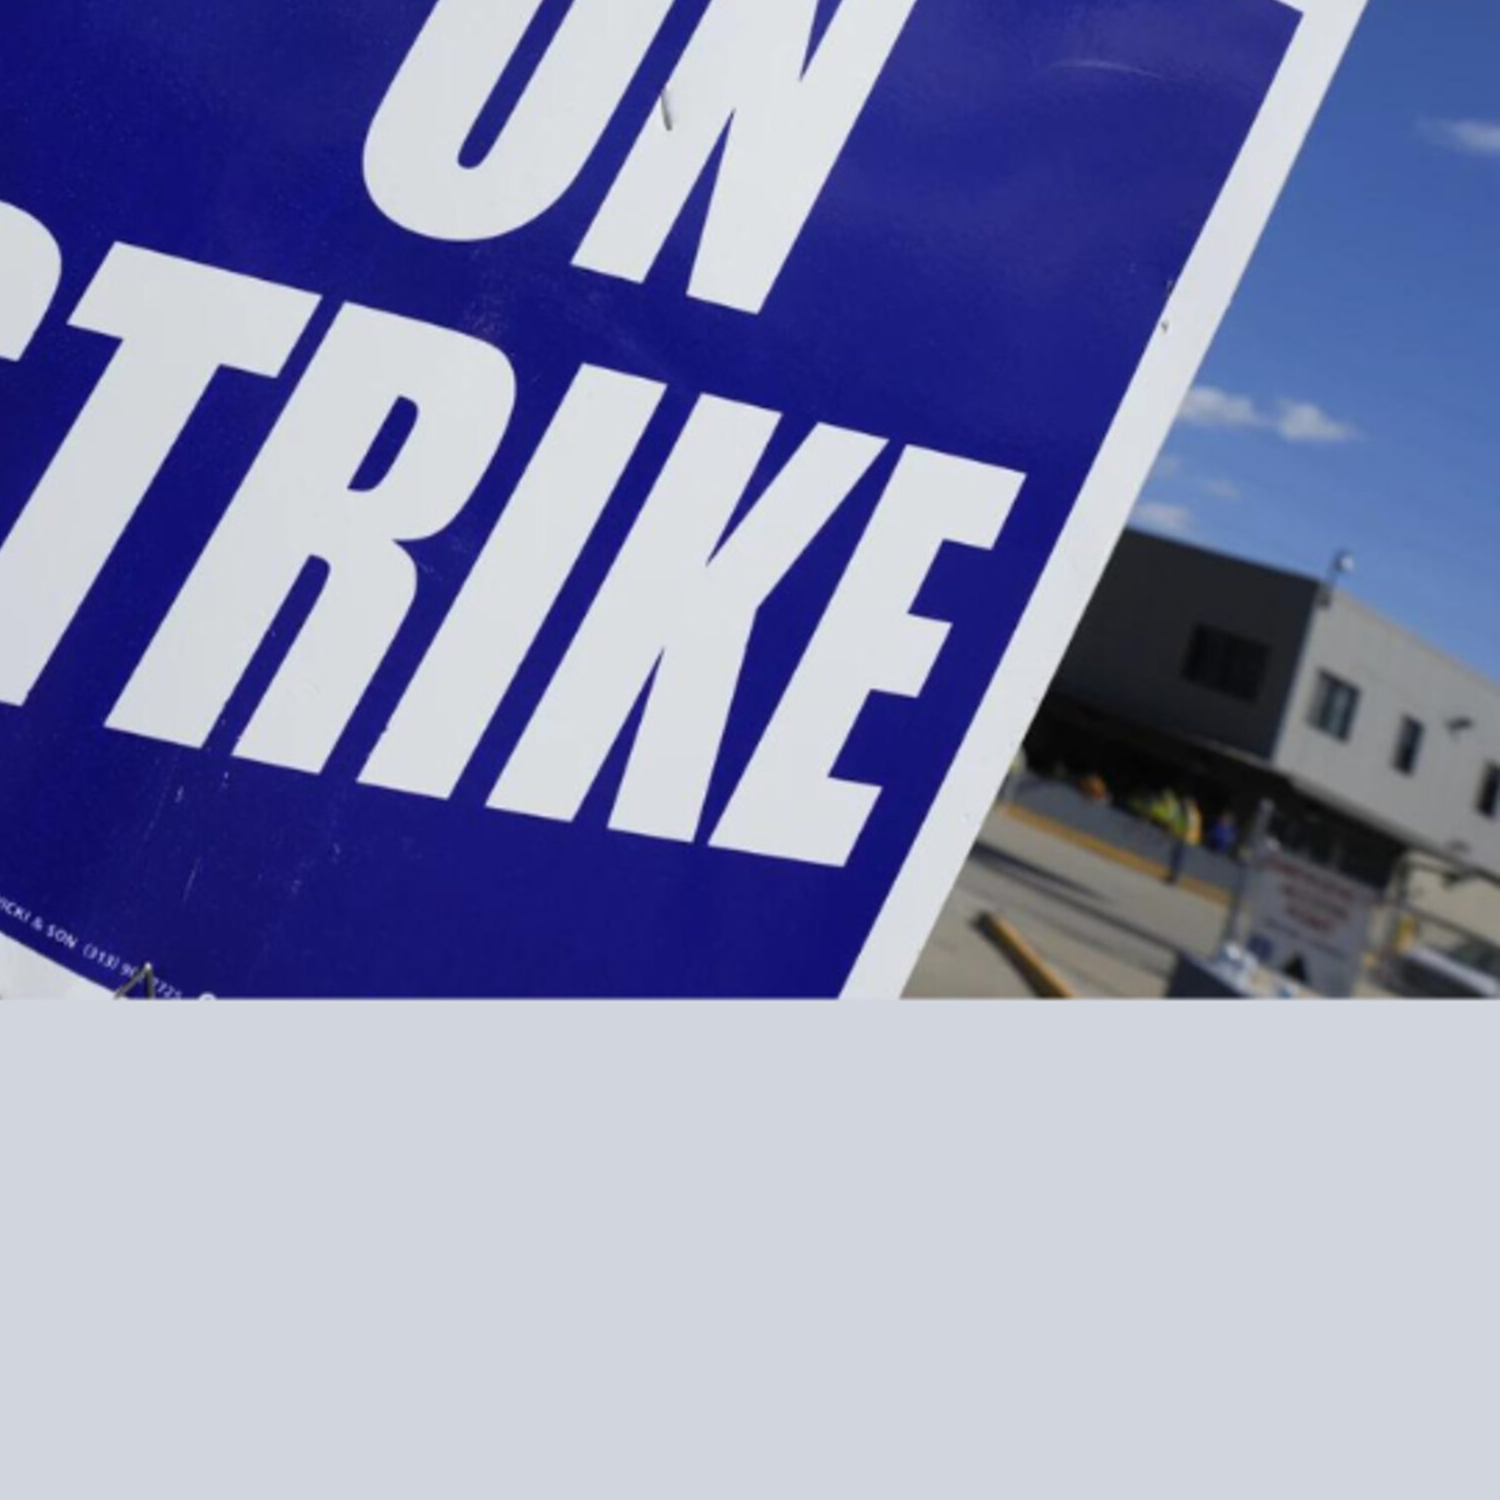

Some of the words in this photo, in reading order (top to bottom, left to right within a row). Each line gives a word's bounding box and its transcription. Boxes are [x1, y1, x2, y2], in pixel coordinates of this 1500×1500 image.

[31, 915, 44, 932] &
[47, 923, 78, 949] SON
[82, 942, 121, 971] (313)
